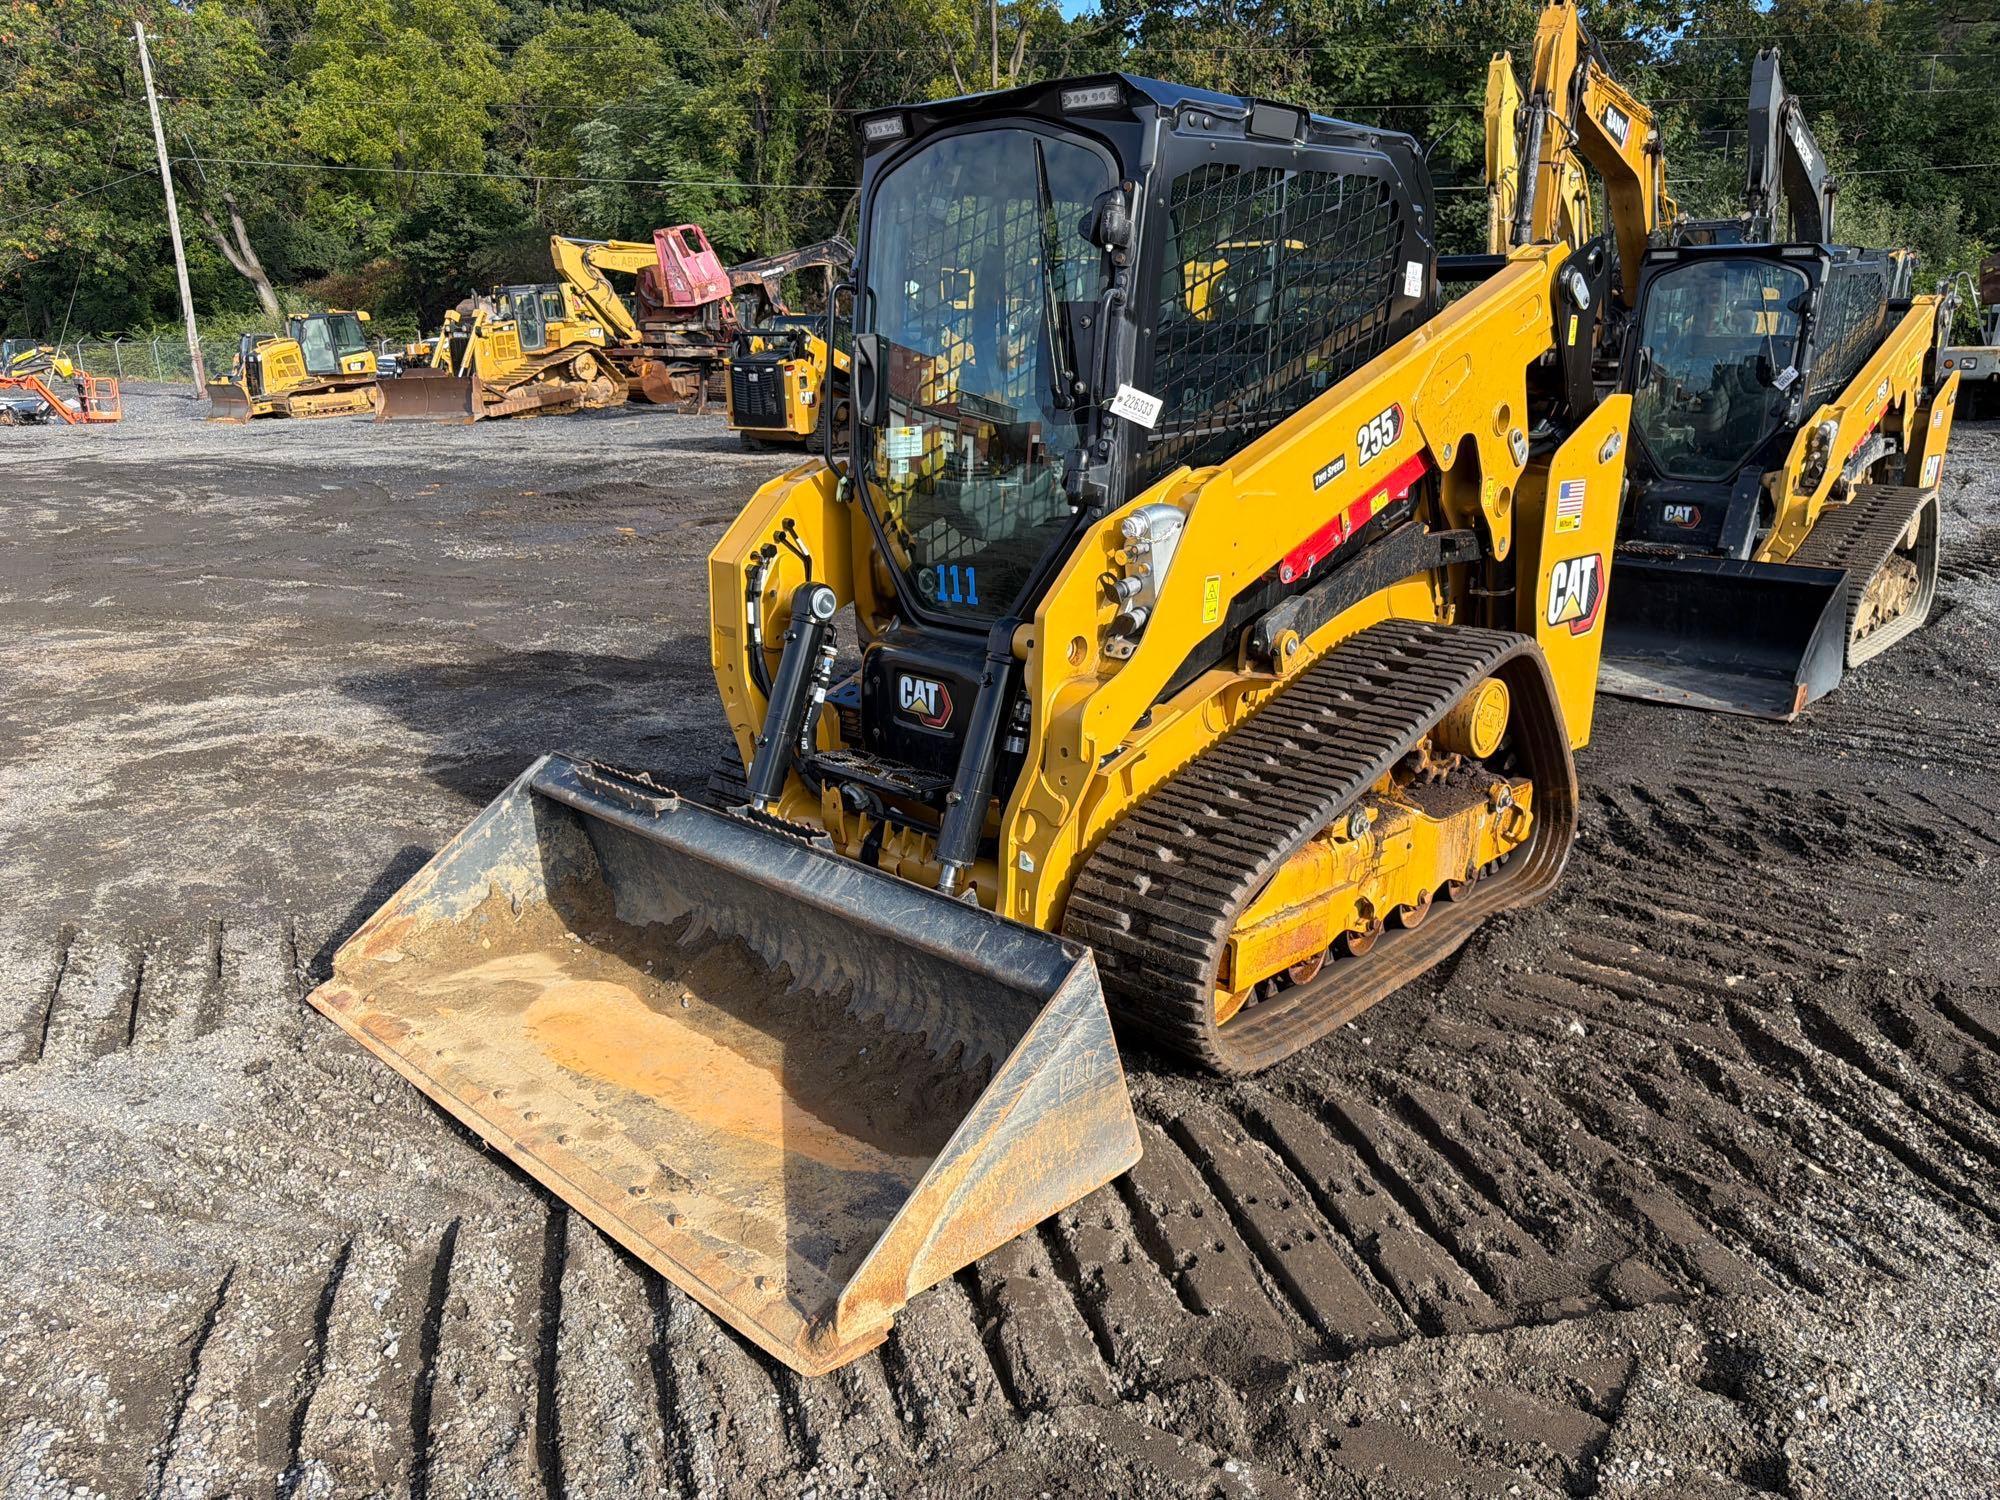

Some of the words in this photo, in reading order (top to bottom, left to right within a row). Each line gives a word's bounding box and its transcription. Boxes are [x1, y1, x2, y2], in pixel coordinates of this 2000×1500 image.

[1606, 106, 1627, 140] SANY
[800, 391, 814, 405] CAT
[1123, 393, 1154, 417] 226333
[1357, 407, 1394, 465] 255
[1664, 504, 1693, 523] CAT
[936, 564, 979, 605] 111
[1547, 554, 1597, 625] CAT
[900, 676, 939, 716] CAT
